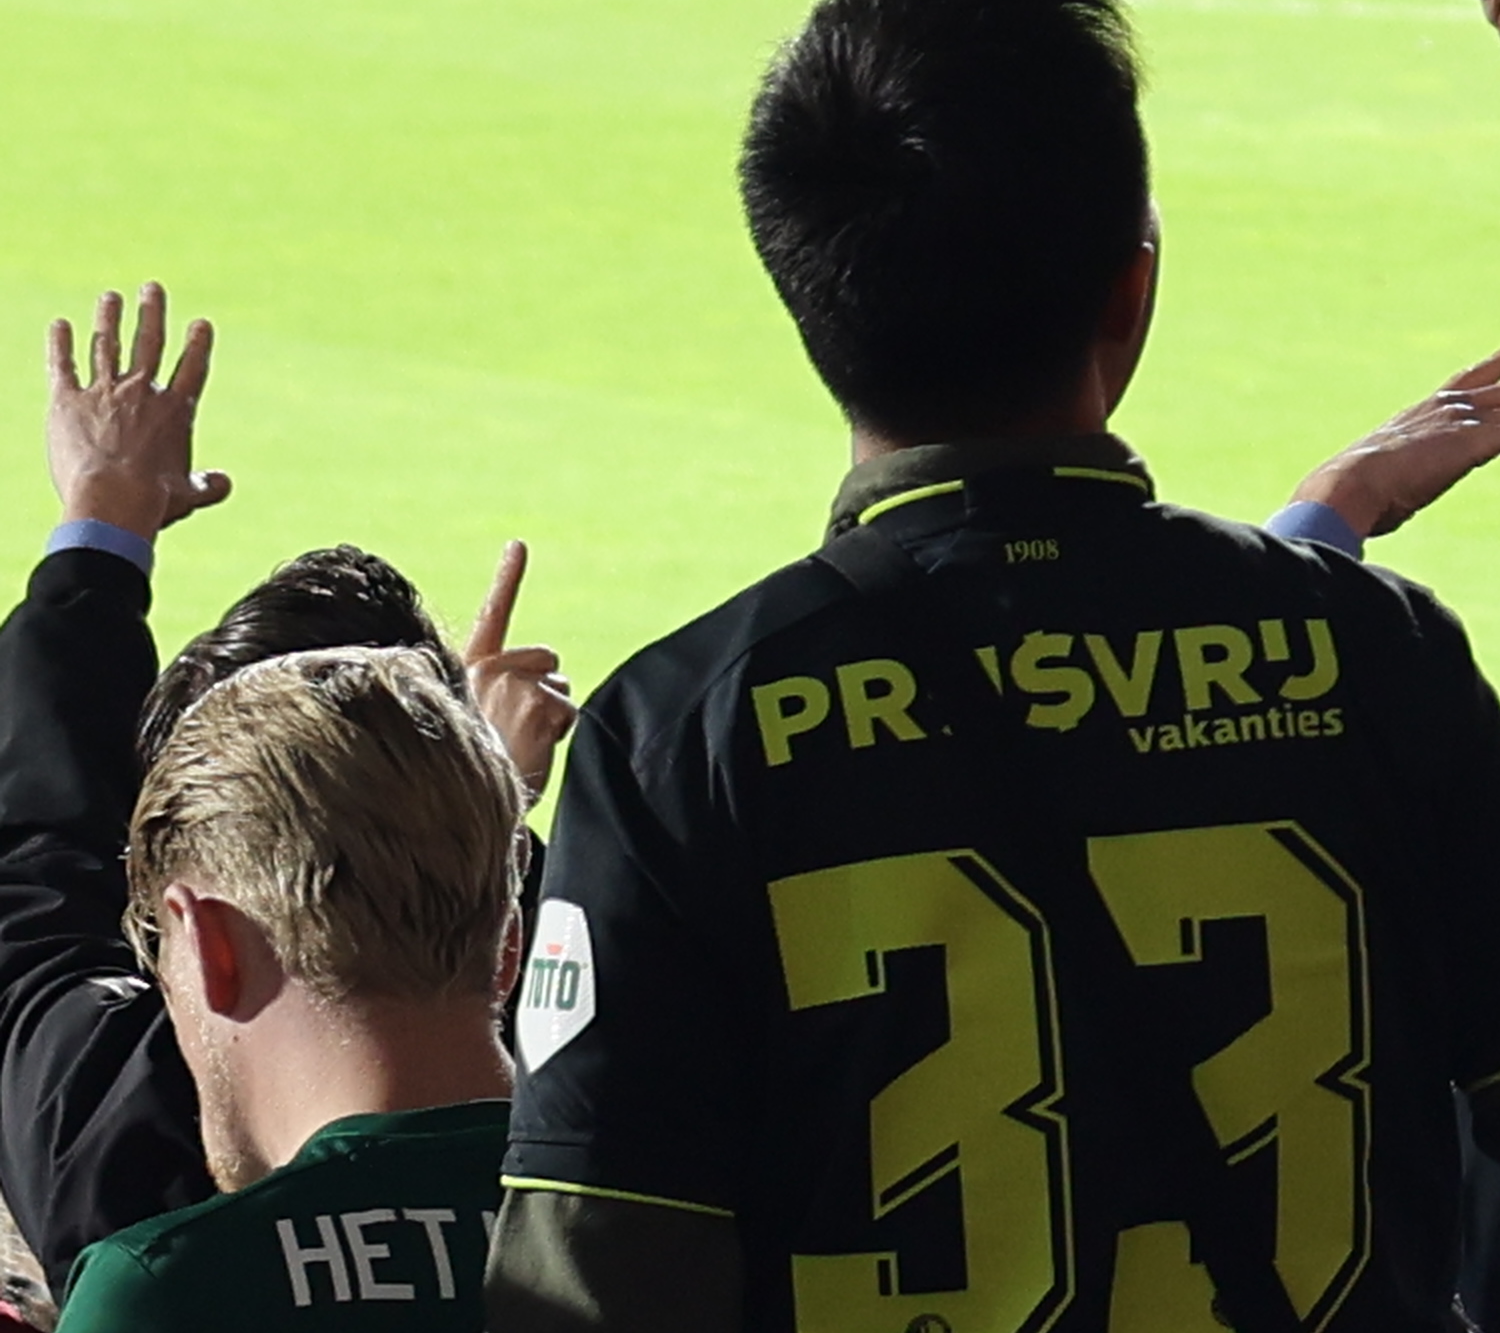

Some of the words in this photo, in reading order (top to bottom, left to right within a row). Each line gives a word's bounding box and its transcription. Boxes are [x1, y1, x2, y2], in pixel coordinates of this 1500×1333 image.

[1003, 537, 1060, 564] 1908
[751, 617, 1340, 767] PRSVRIJ
[1128, 702, 1345, 754] vakanties
[767, 819, 1371, 1333] 33
[275, 1207, 457, 1307] HET
